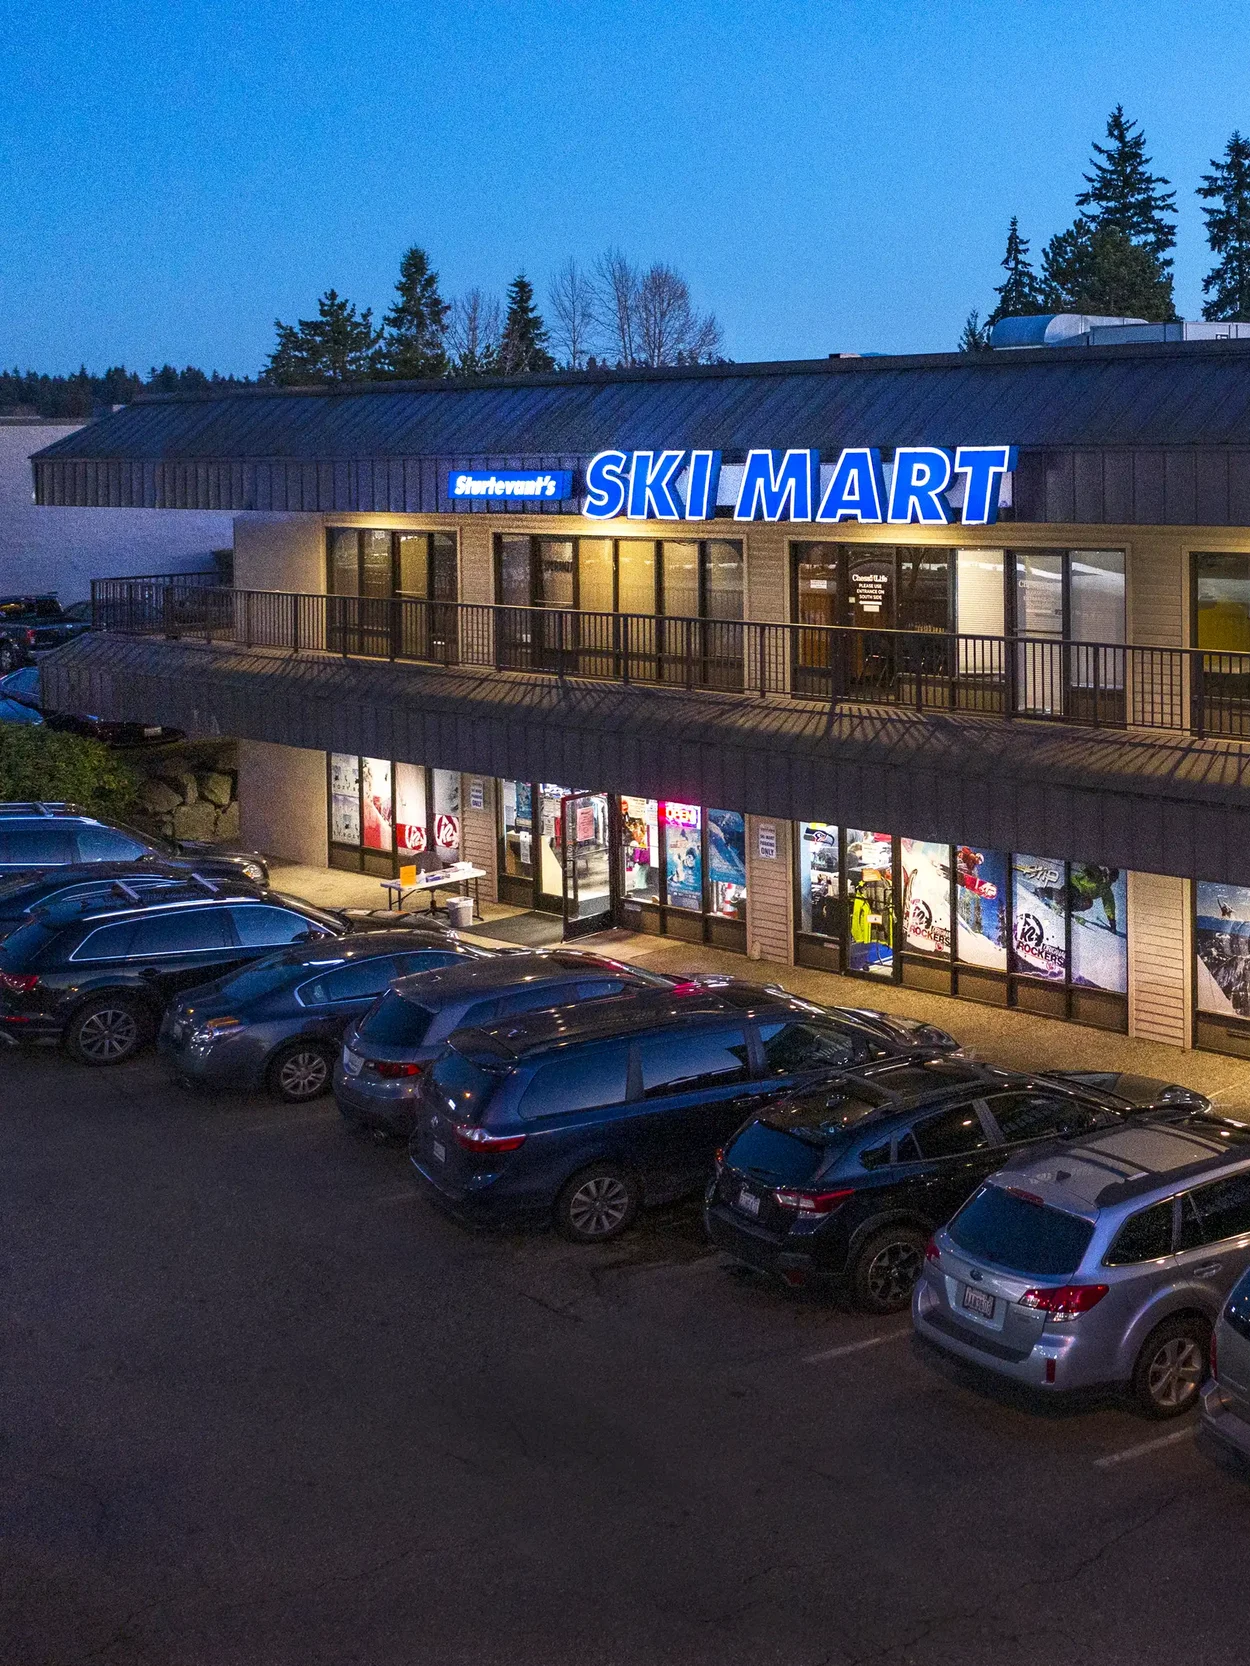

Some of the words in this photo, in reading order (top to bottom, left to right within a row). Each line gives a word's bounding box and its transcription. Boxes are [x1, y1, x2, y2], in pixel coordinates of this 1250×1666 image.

[454, 475, 557, 496] Sturtevant's
[581, 450, 714, 521] SKI
[733, 445, 1011, 526] MART
[666, 807, 695, 822] OPEN
[760, 847, 774, 857] ONLY
[910, 925, 951, 947] ROCKERS
[1016, 941, 1067, 968] ROCKERS
